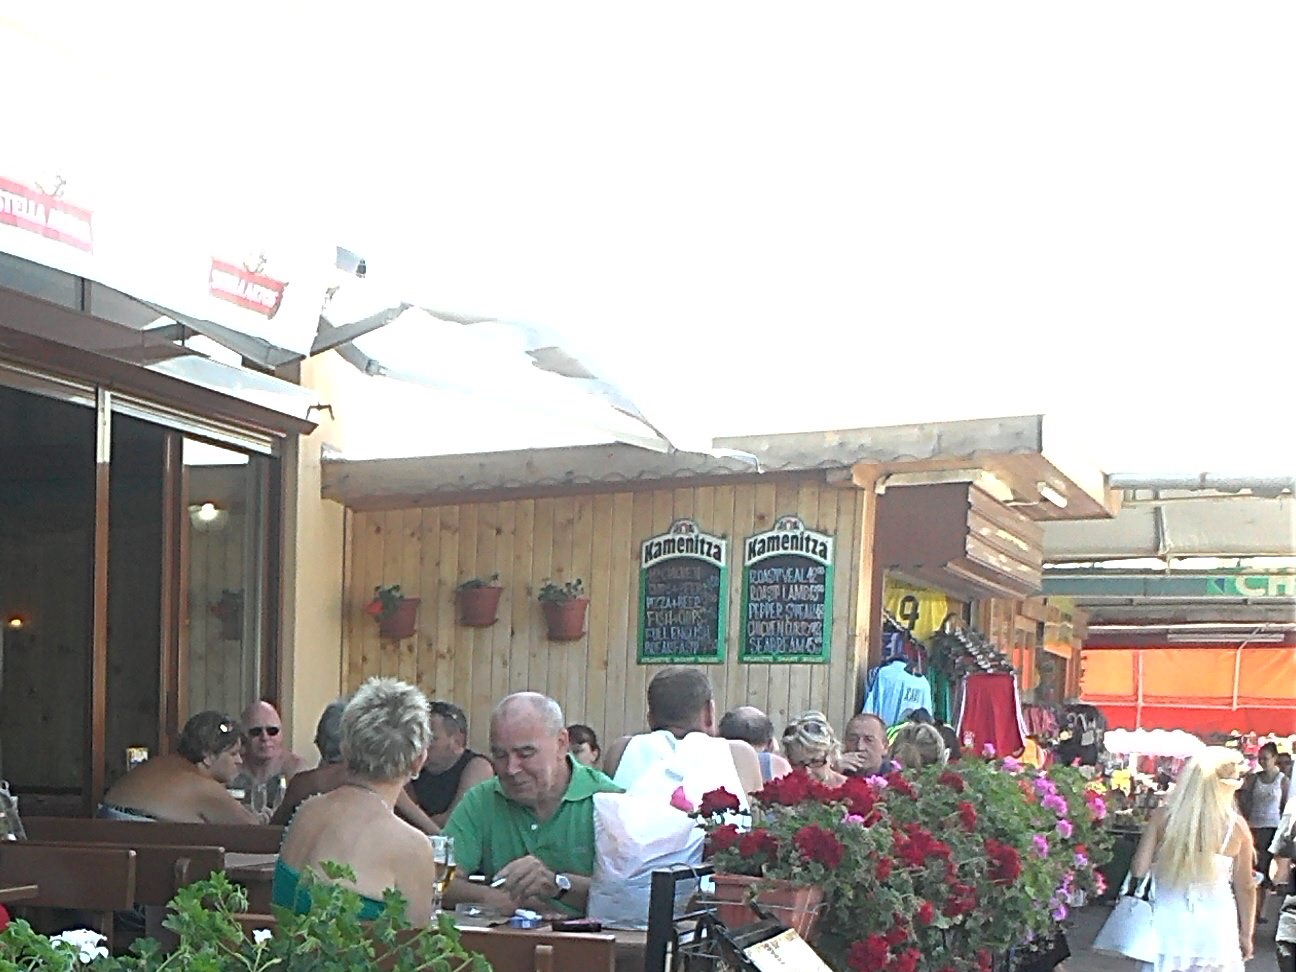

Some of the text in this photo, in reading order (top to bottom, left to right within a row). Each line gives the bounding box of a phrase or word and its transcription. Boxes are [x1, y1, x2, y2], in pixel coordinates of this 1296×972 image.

[644, 533, 722, 564] Kamenitza
[747, 531, 828, 561] Kamenitza
[899, 595, 920, 630] 9
